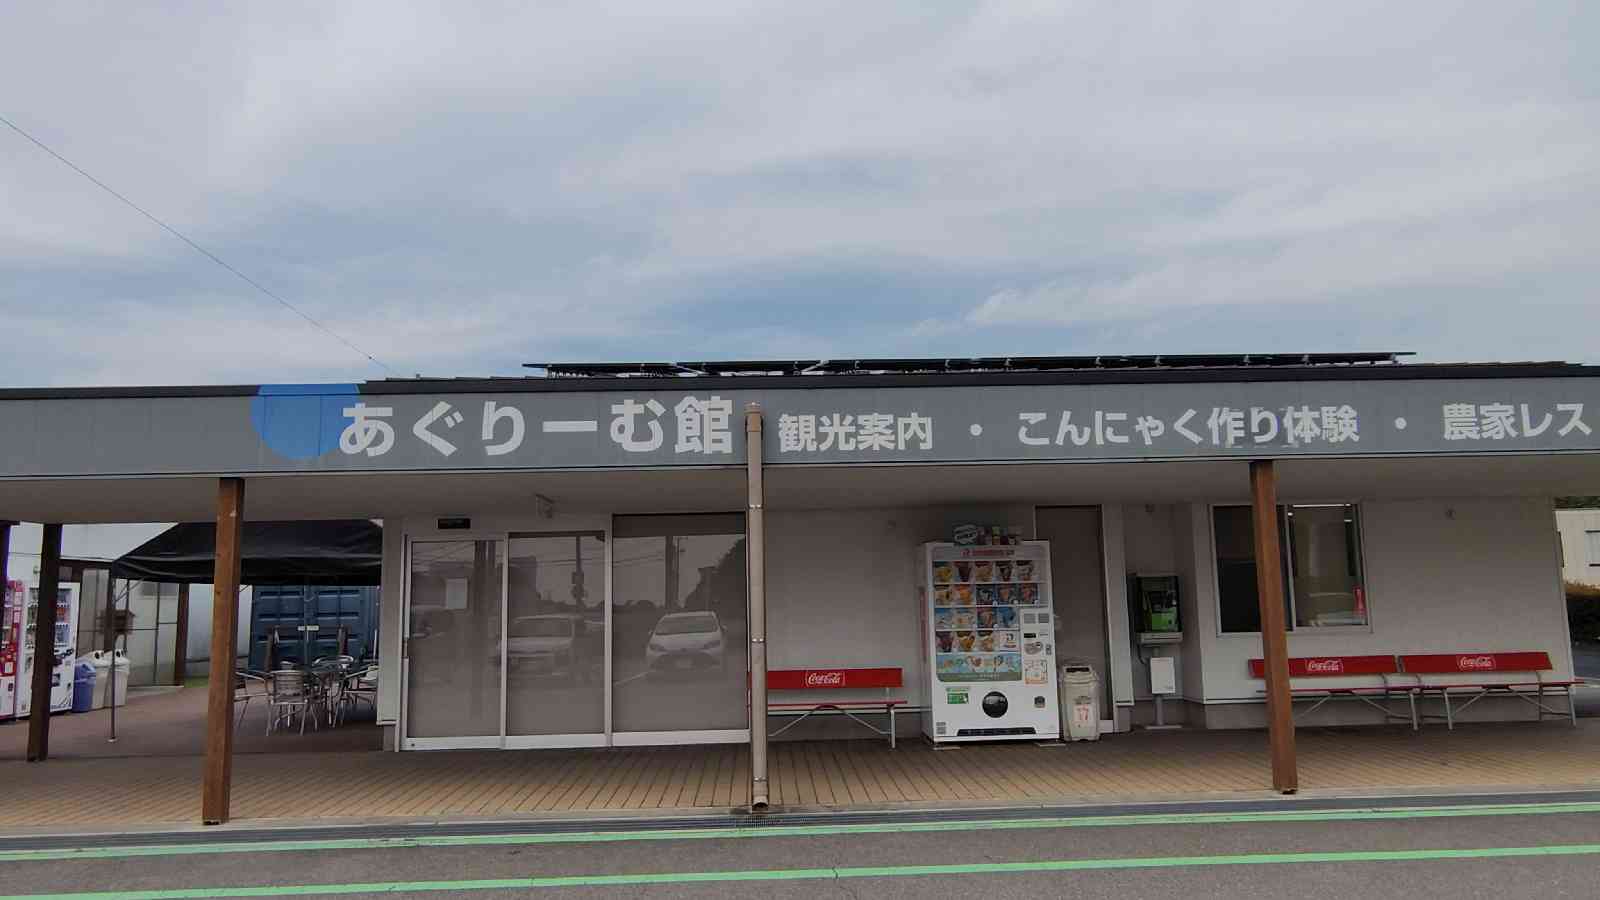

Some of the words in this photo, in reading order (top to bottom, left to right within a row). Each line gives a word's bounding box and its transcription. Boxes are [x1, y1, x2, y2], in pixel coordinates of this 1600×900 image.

[338, 395, 733, 457] あぐりーむ館
[778, 412, 933, 453] 観光案内
[1018, 404, 1360, 446] こんにゃく作り体験
[1442, 402, 1592, 441] 農家レス
[1307, 660, 1339, 672] Coca-Cola
[1460, 656, 1492, 668] Coca-Cola
[807, 672, 841, 685] Coca-Cola
